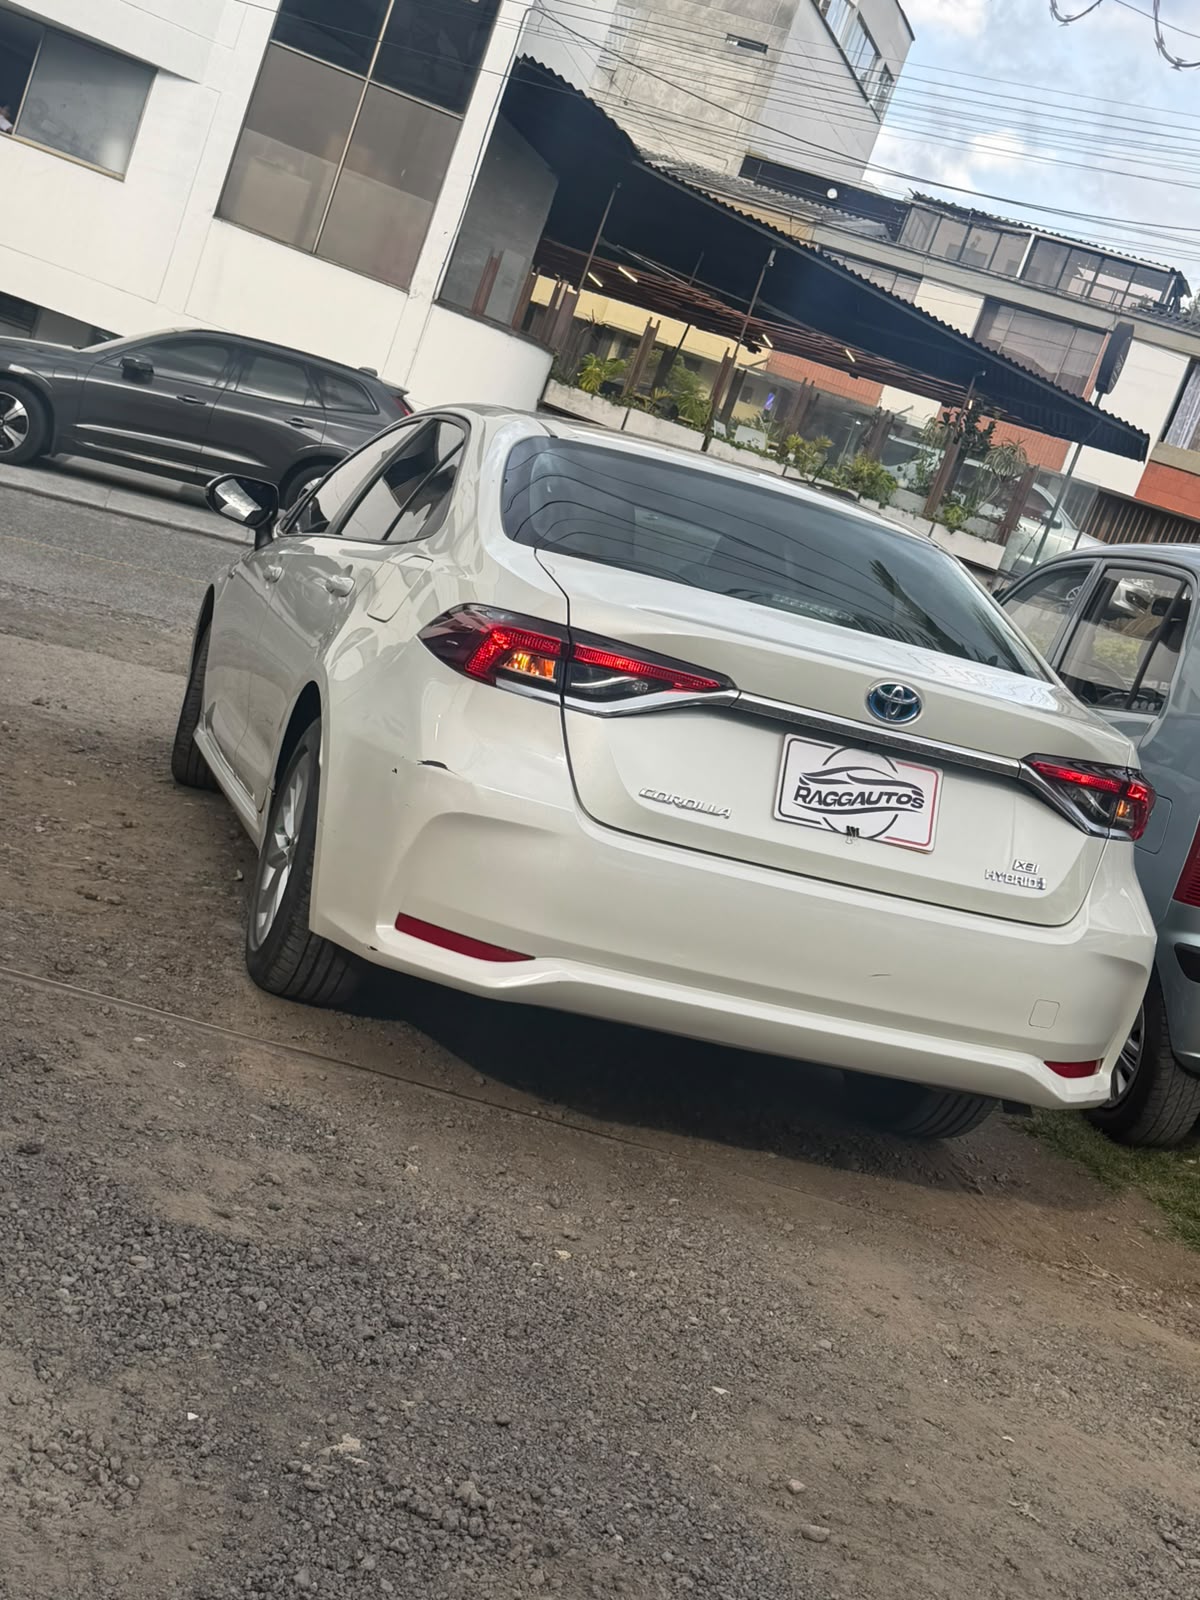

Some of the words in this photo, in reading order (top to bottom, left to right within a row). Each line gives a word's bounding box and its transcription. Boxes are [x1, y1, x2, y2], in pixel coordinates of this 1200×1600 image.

[638, 787, 732, 819] COROLLA
[793, 785, 925, 809] RAGGAUTOS
[984, 868, 1037, 888] HYBRID
